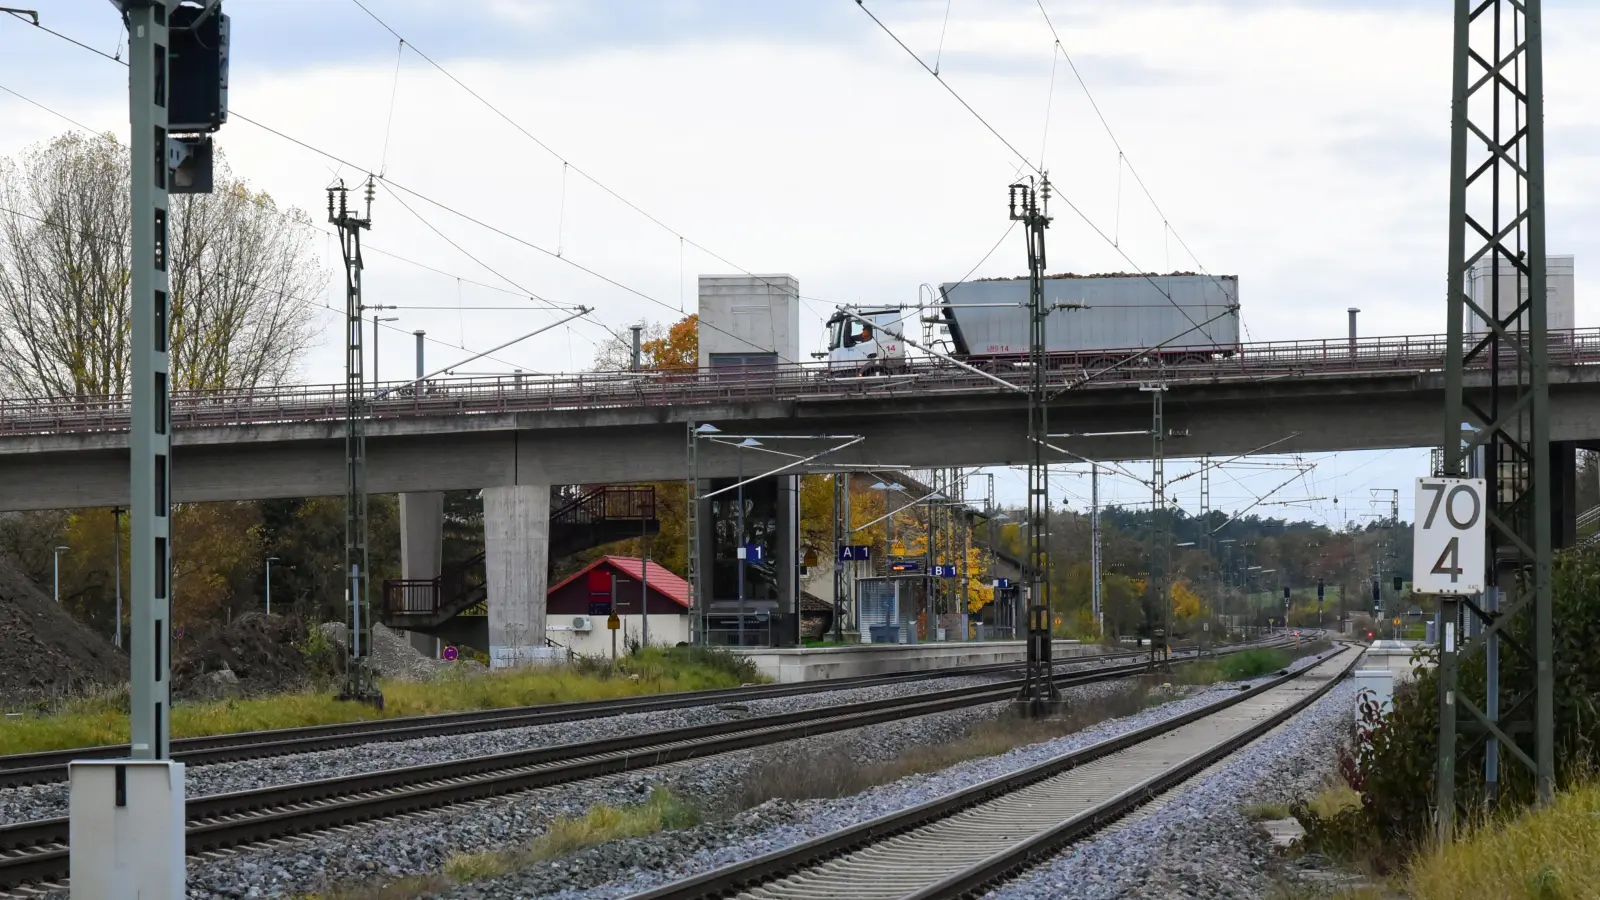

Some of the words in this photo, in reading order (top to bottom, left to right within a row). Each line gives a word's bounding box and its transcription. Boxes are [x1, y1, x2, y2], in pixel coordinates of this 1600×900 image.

[1421, 483, 1481, 531] 70
[755, 546, 762, 560] 1
[843, 546, 852, 558] A
[863, 546, 868, 558] 1
[1430, 536, 1464, 583] 4
[935, 566, 943, 576] B
[951, 566, 956, 576] 1
[1003, 578, 1008, 588] 1
